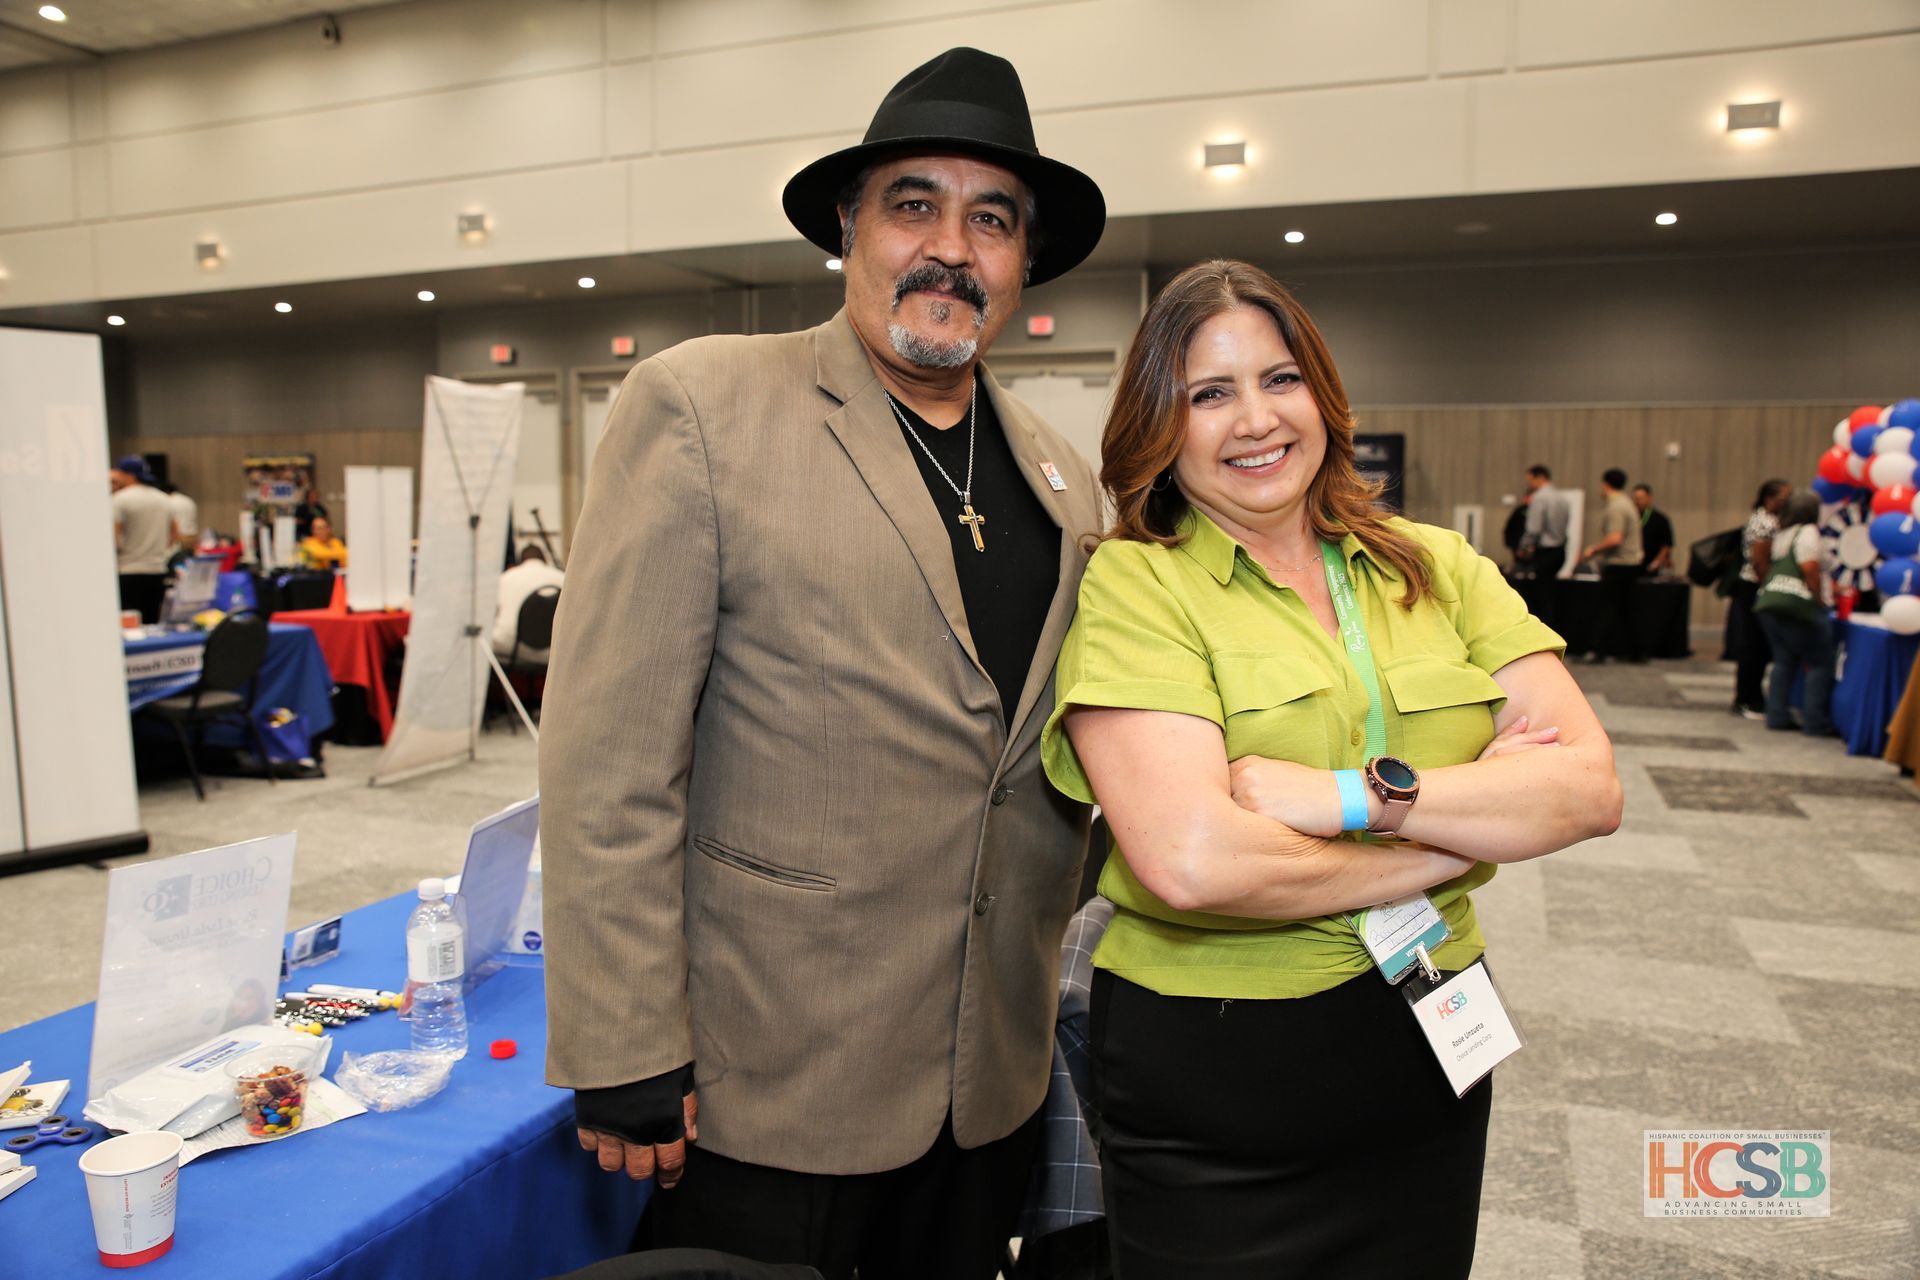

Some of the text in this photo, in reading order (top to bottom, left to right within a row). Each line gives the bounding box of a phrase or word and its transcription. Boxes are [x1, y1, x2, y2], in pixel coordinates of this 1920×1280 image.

[1436, 991, 1468, 1020] HCSB
[1452, 1022, 1485, 1048] Rosie Unzueta
